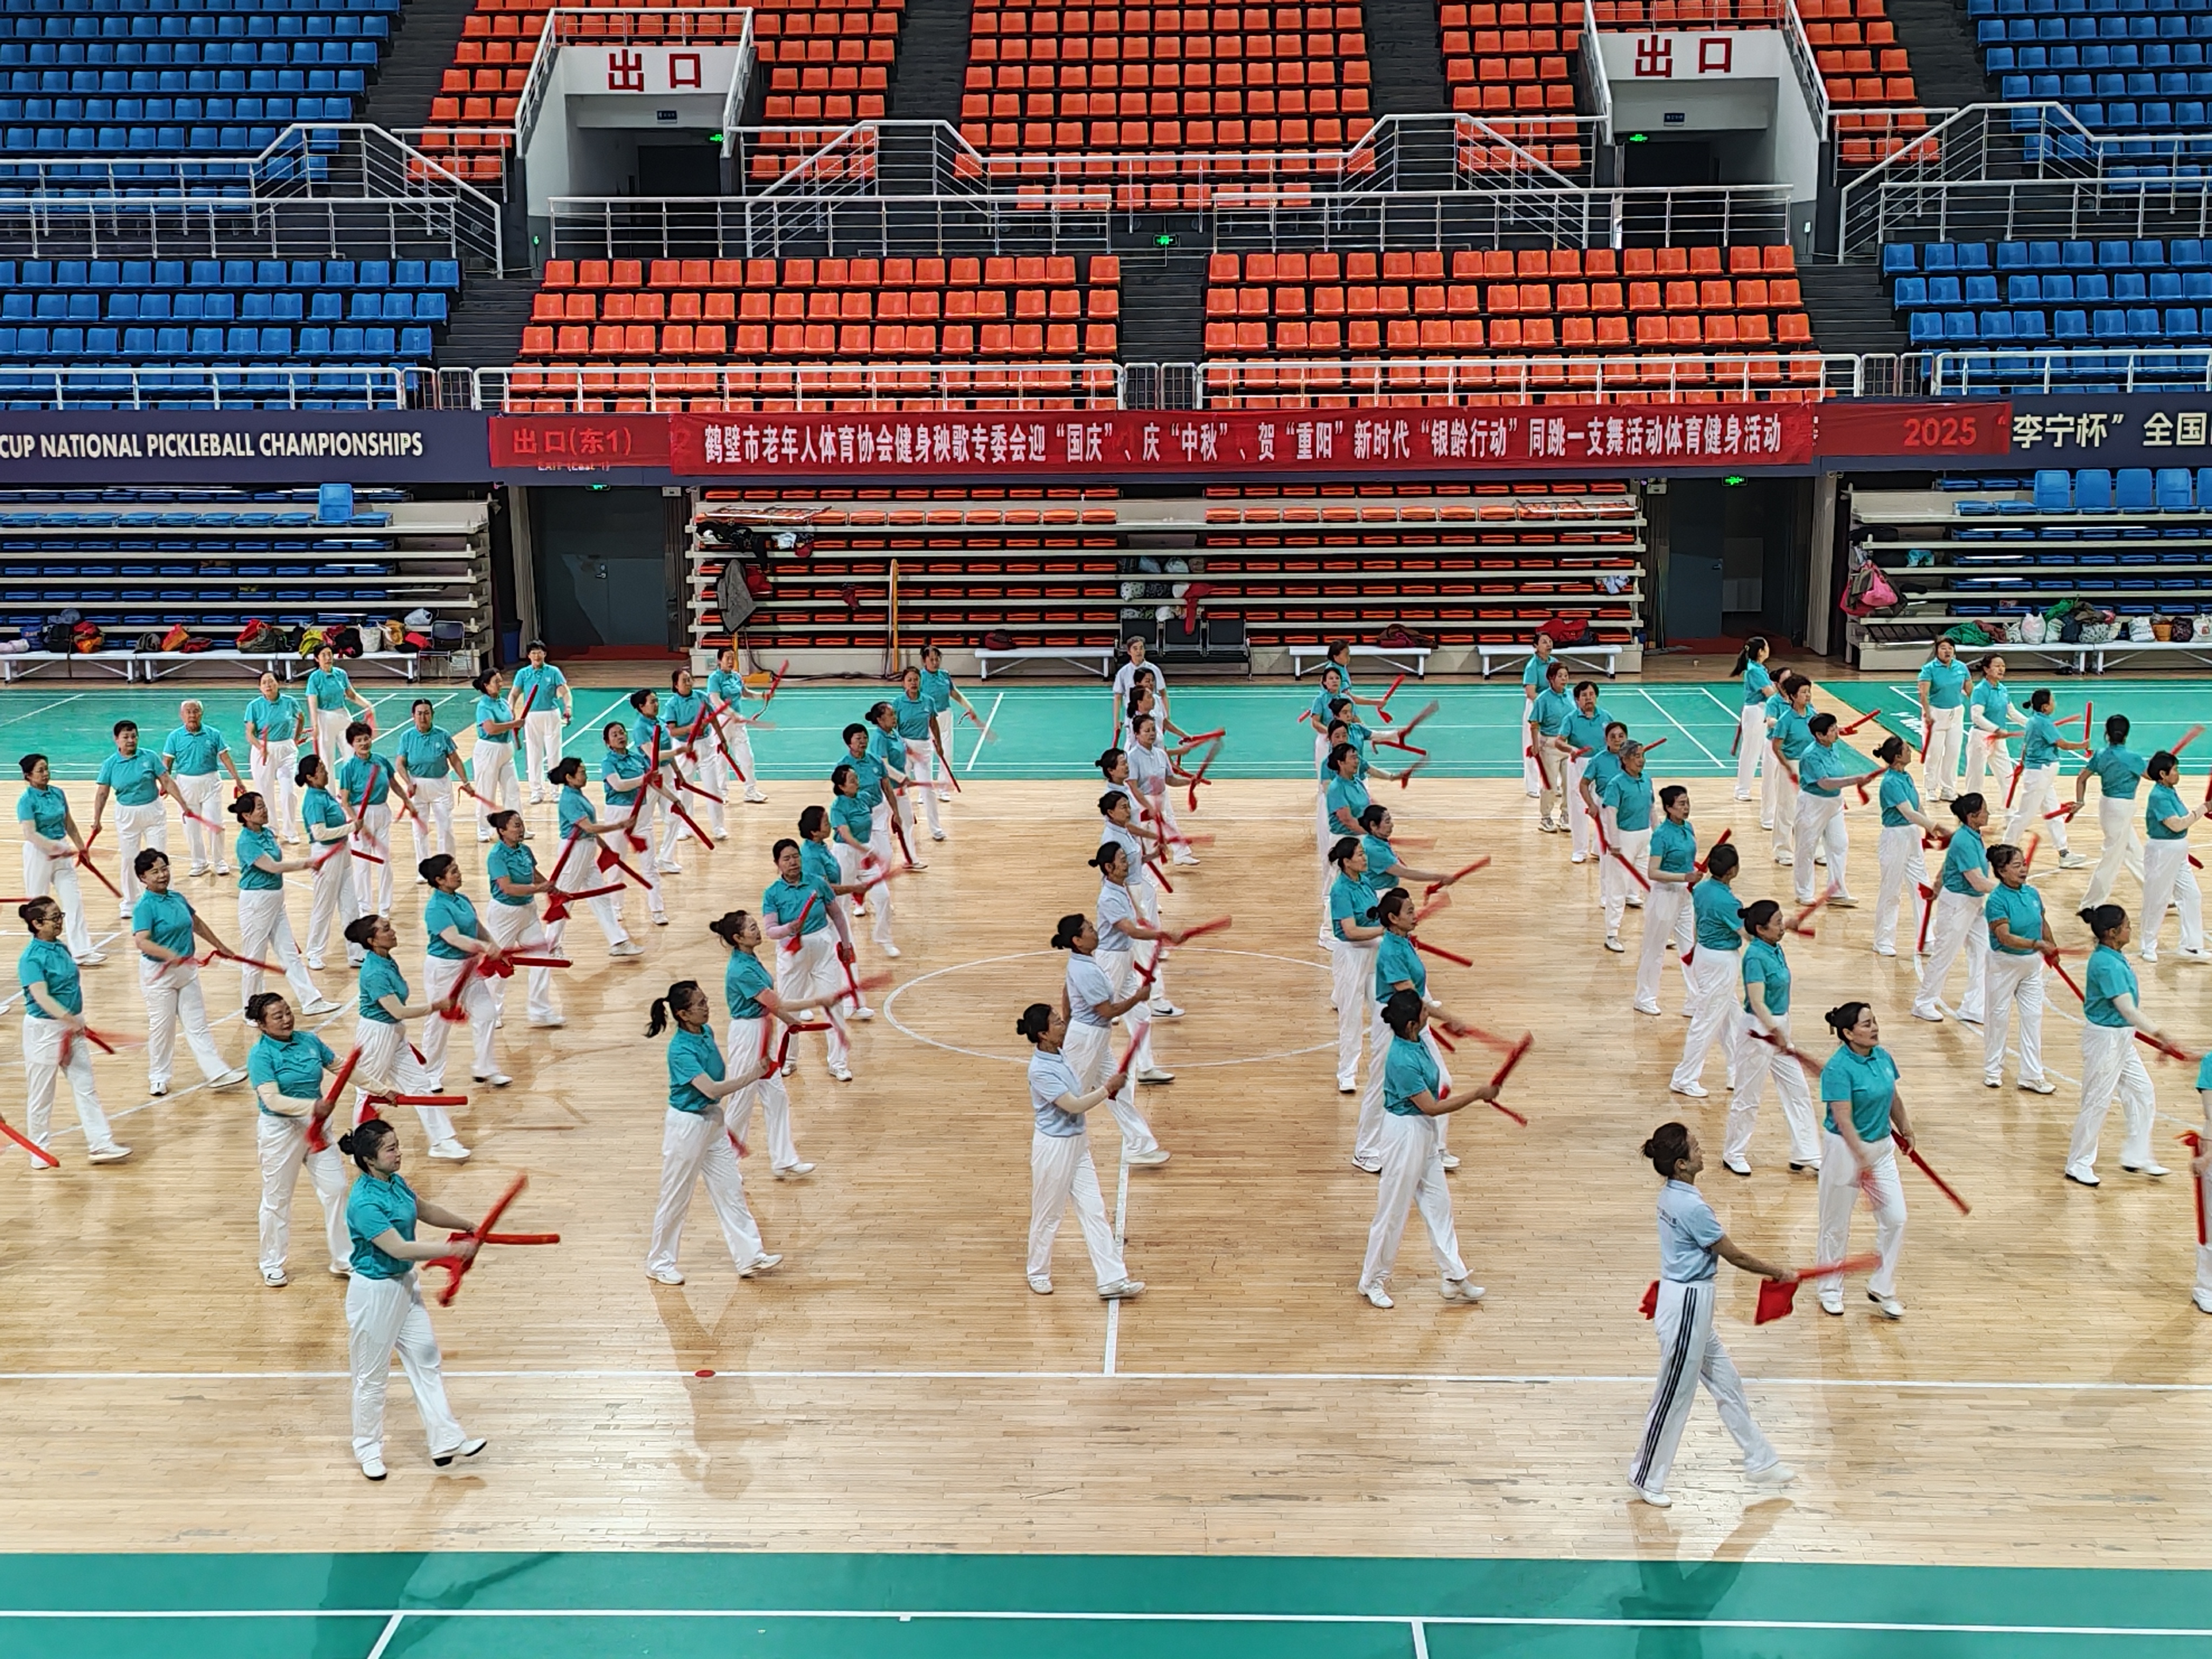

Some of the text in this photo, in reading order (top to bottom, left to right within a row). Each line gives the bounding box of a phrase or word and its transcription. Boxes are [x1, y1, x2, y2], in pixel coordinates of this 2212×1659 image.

[608, 49, 702, 92] 出口
[1635, 35, 1732, 78] 出口
[0, 431, 423, 458] CUP NATIONAL PICKLEBALL CHAMPIONSHIPS
[1903, 416, 1977, 446] 2025
